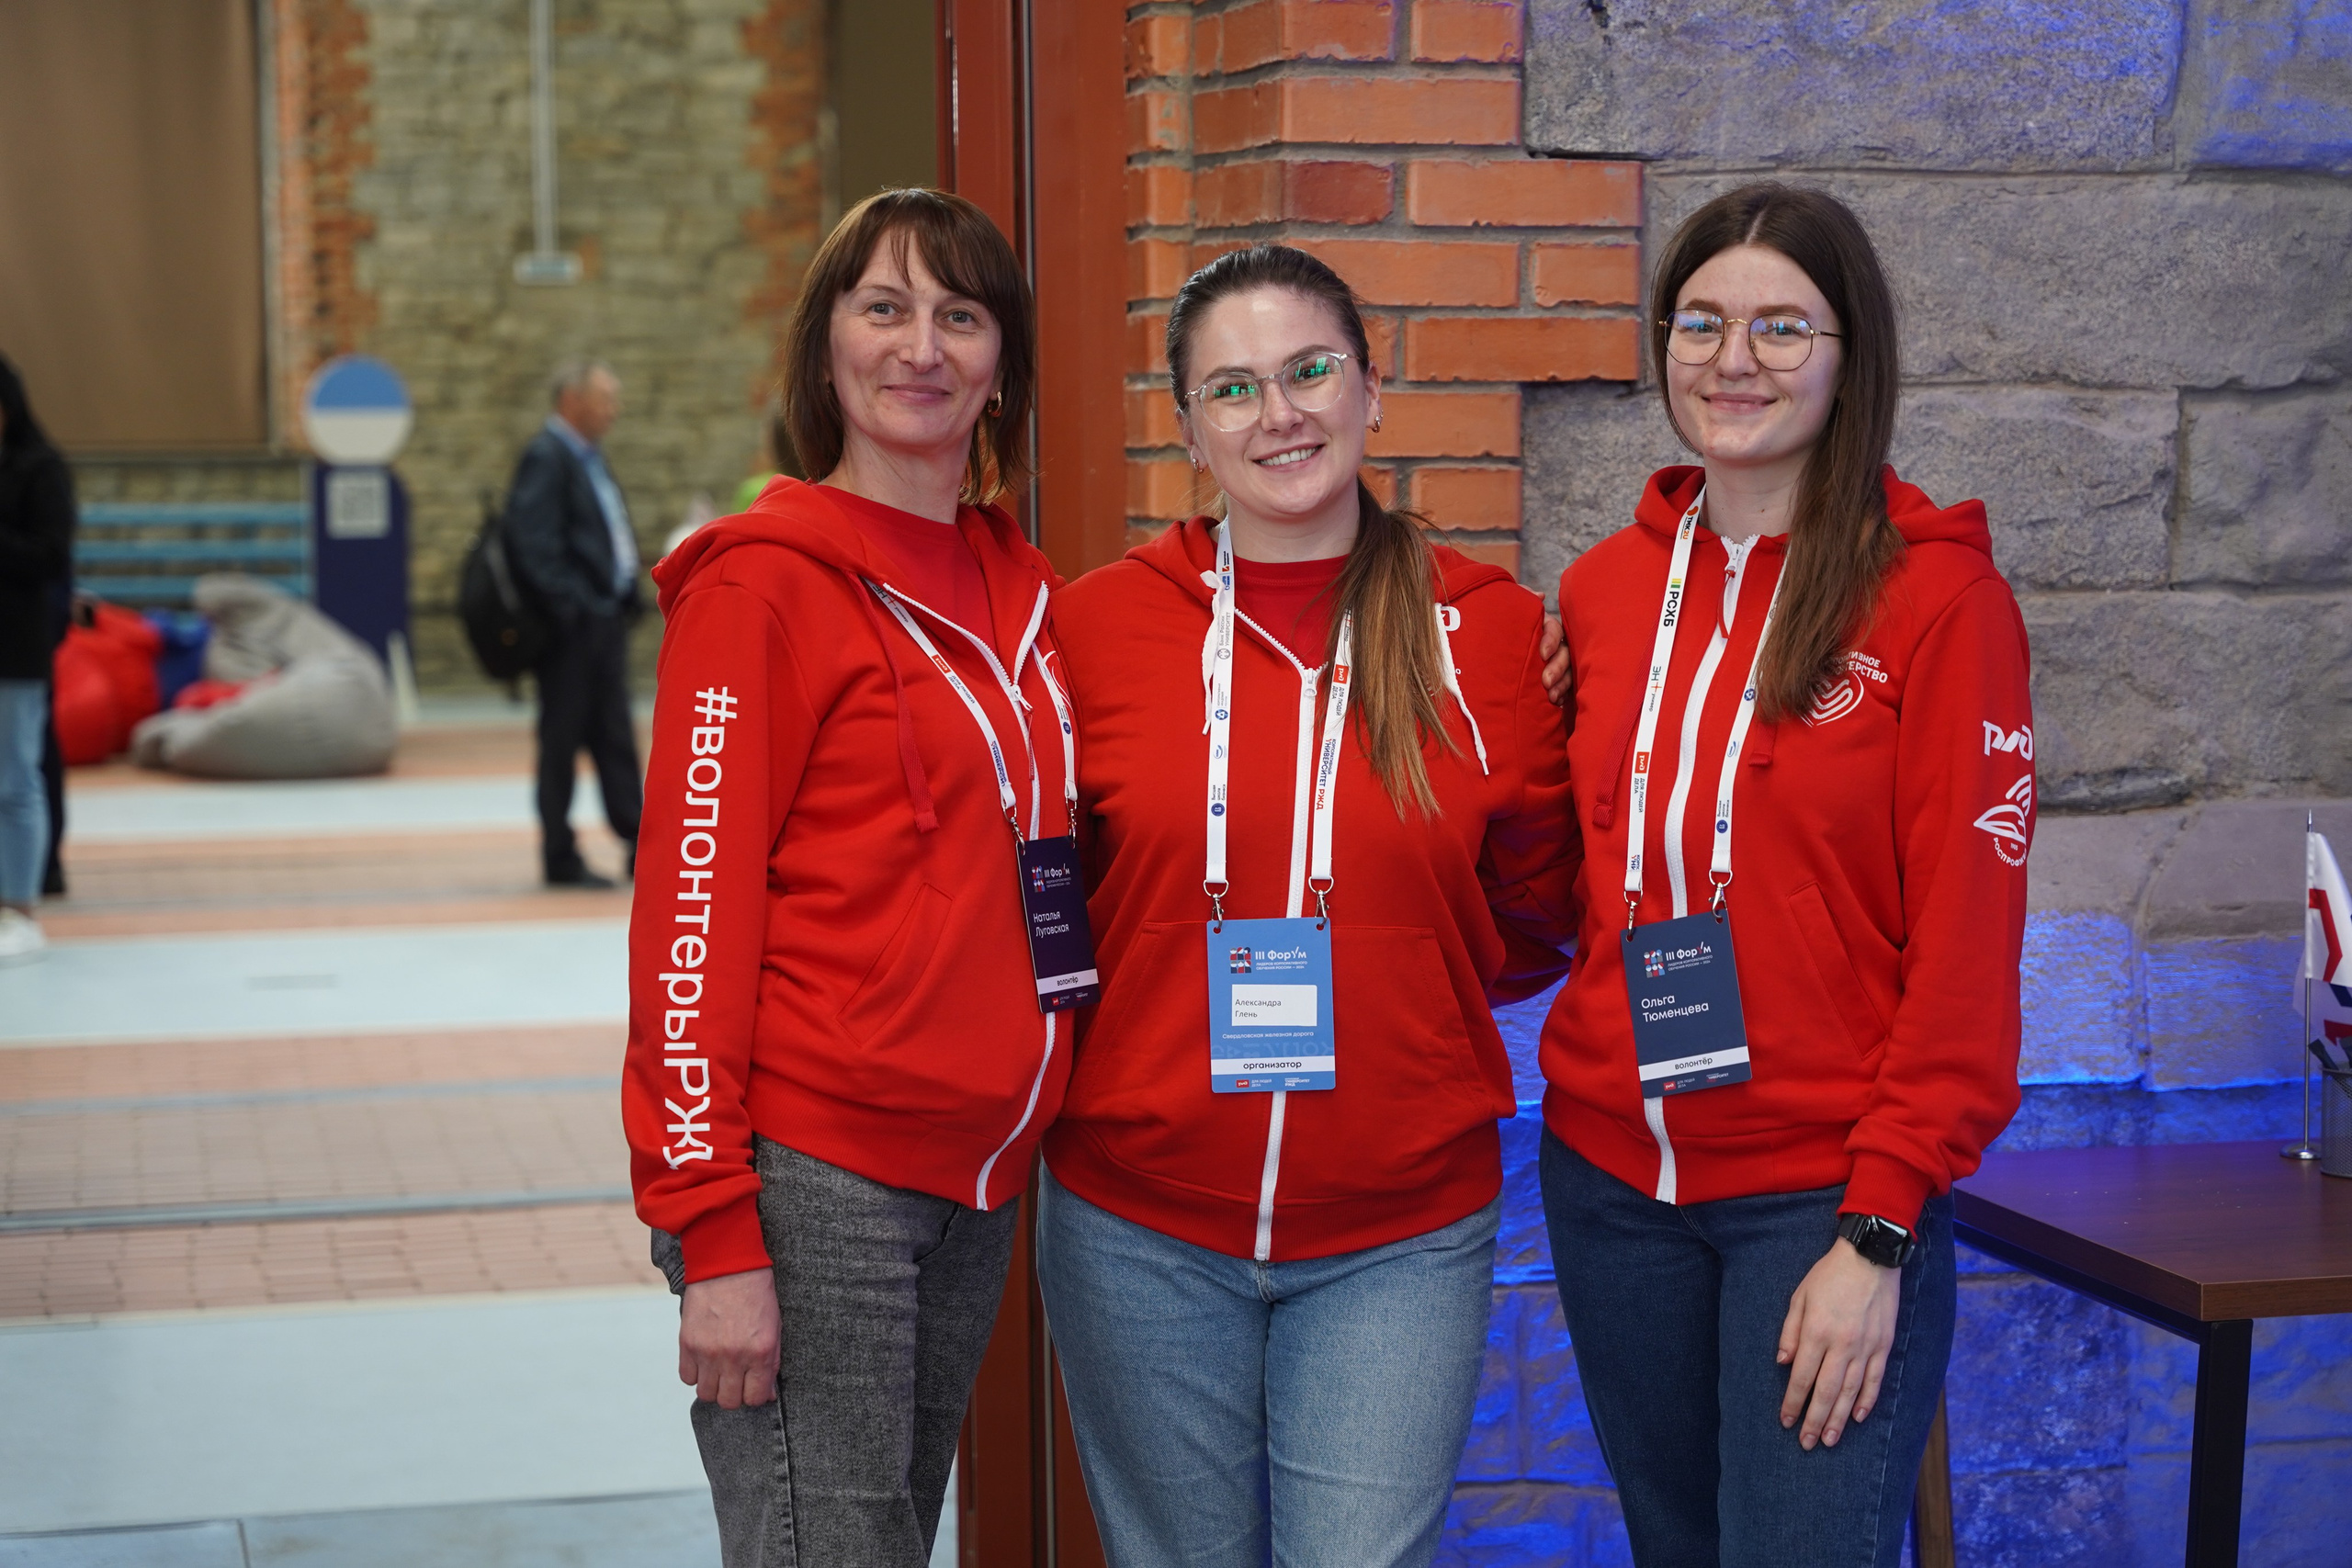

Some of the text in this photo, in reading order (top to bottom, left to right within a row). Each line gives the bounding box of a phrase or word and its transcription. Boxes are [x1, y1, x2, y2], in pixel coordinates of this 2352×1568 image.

[1663, 591, 1679, 627] РСХБ
[1328, 739, 1336, 775] КОРПОРАТИВНЫЙ
[1316, 739, 1331, 810] УНИВЕРСИТЕТ РЖД
[1033, 910, 1061, 923] Наталья
[1035, 923, 1070, 939] Луговская
[1255, 951, 1265, 961] III
[1666, 952, 1675, 961] III
[1057, 976, 1079, 987] волонтёр
[1235, 998, 1282, 1009] Александра
[1641, 994, 1676, 1010] Ольга
[1235, 1010, 1258, 1019] Глень
[1643, 1001, 1710, 1023] Тюменцева
[1242, 1060, 1302, 1071] организатор
[1674, 1056, 1713, 1071] волонтёр
